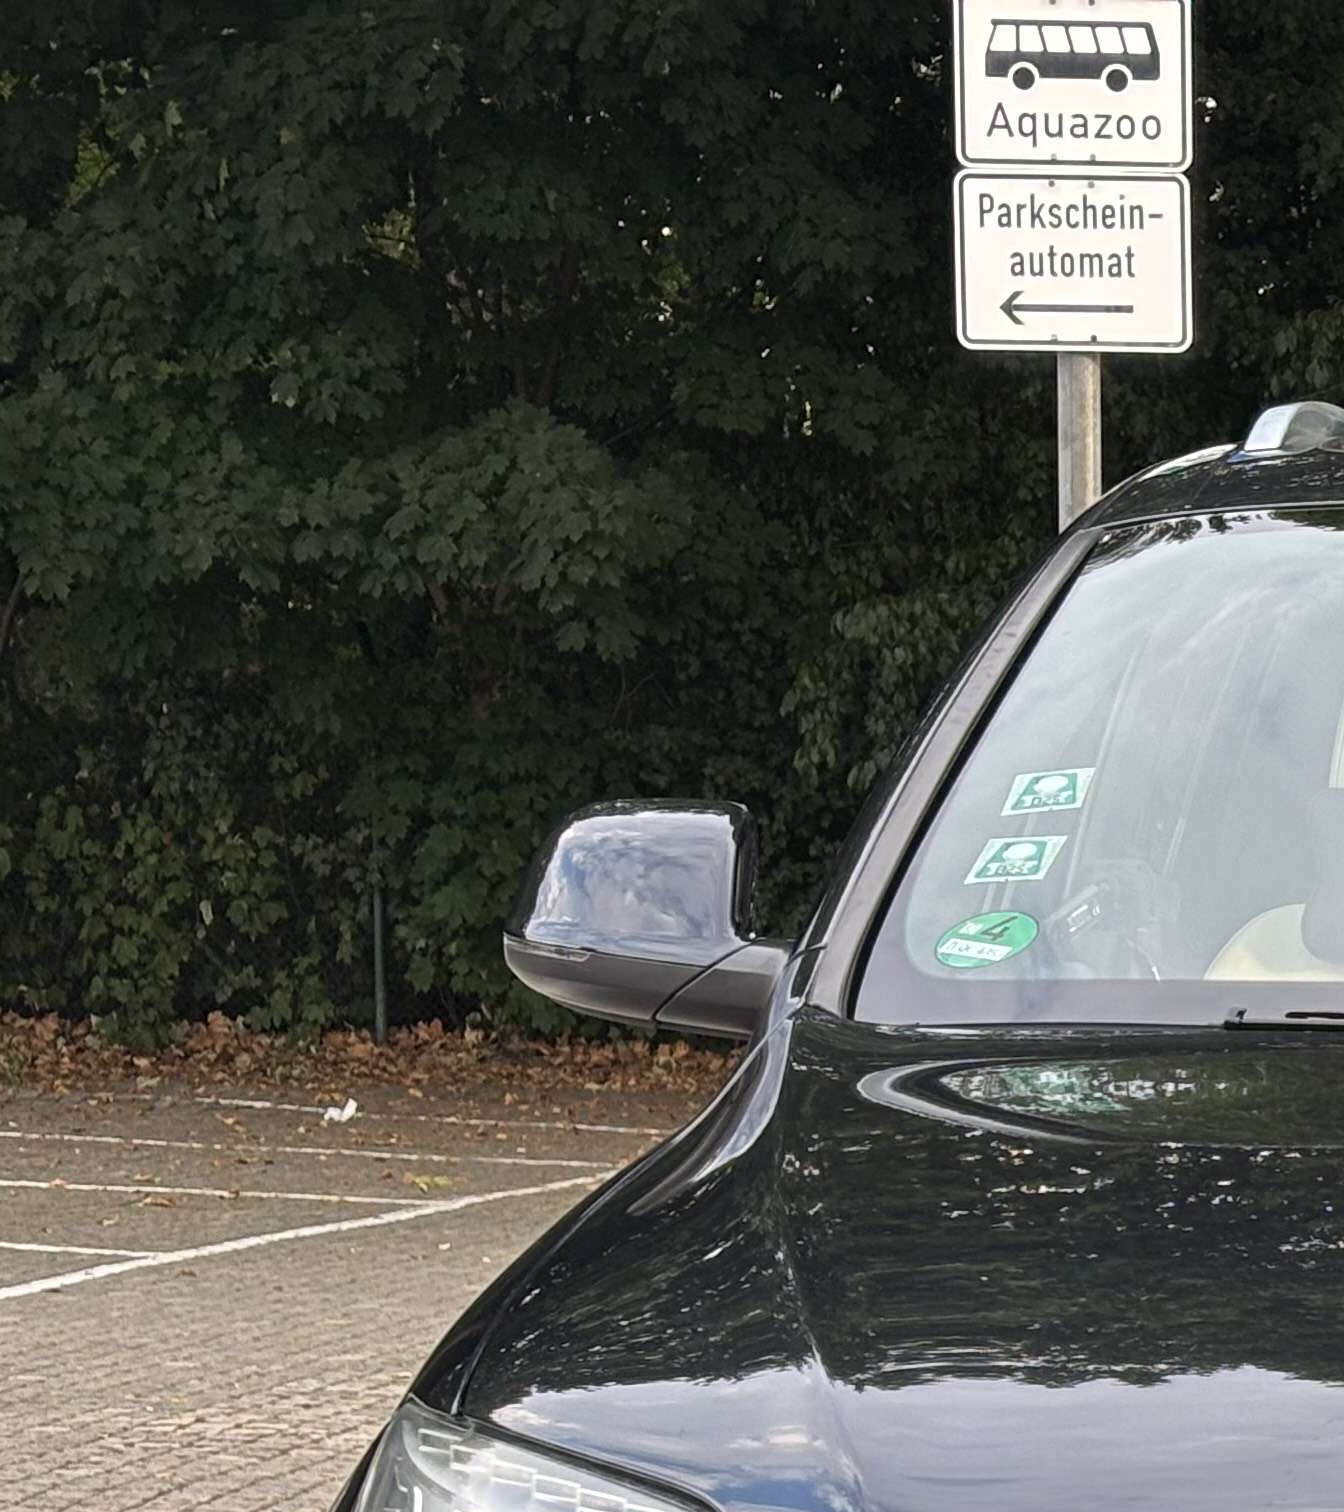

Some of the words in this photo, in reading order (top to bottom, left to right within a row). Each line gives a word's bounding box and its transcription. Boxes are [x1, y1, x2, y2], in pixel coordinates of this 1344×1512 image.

[986, 102, 1162, 148] Aquazoo
[978, 193, 1164, 230] Parkschein-
[1009, 245, 1136, 278] automat
[980, 915, 1018, 941] 4
